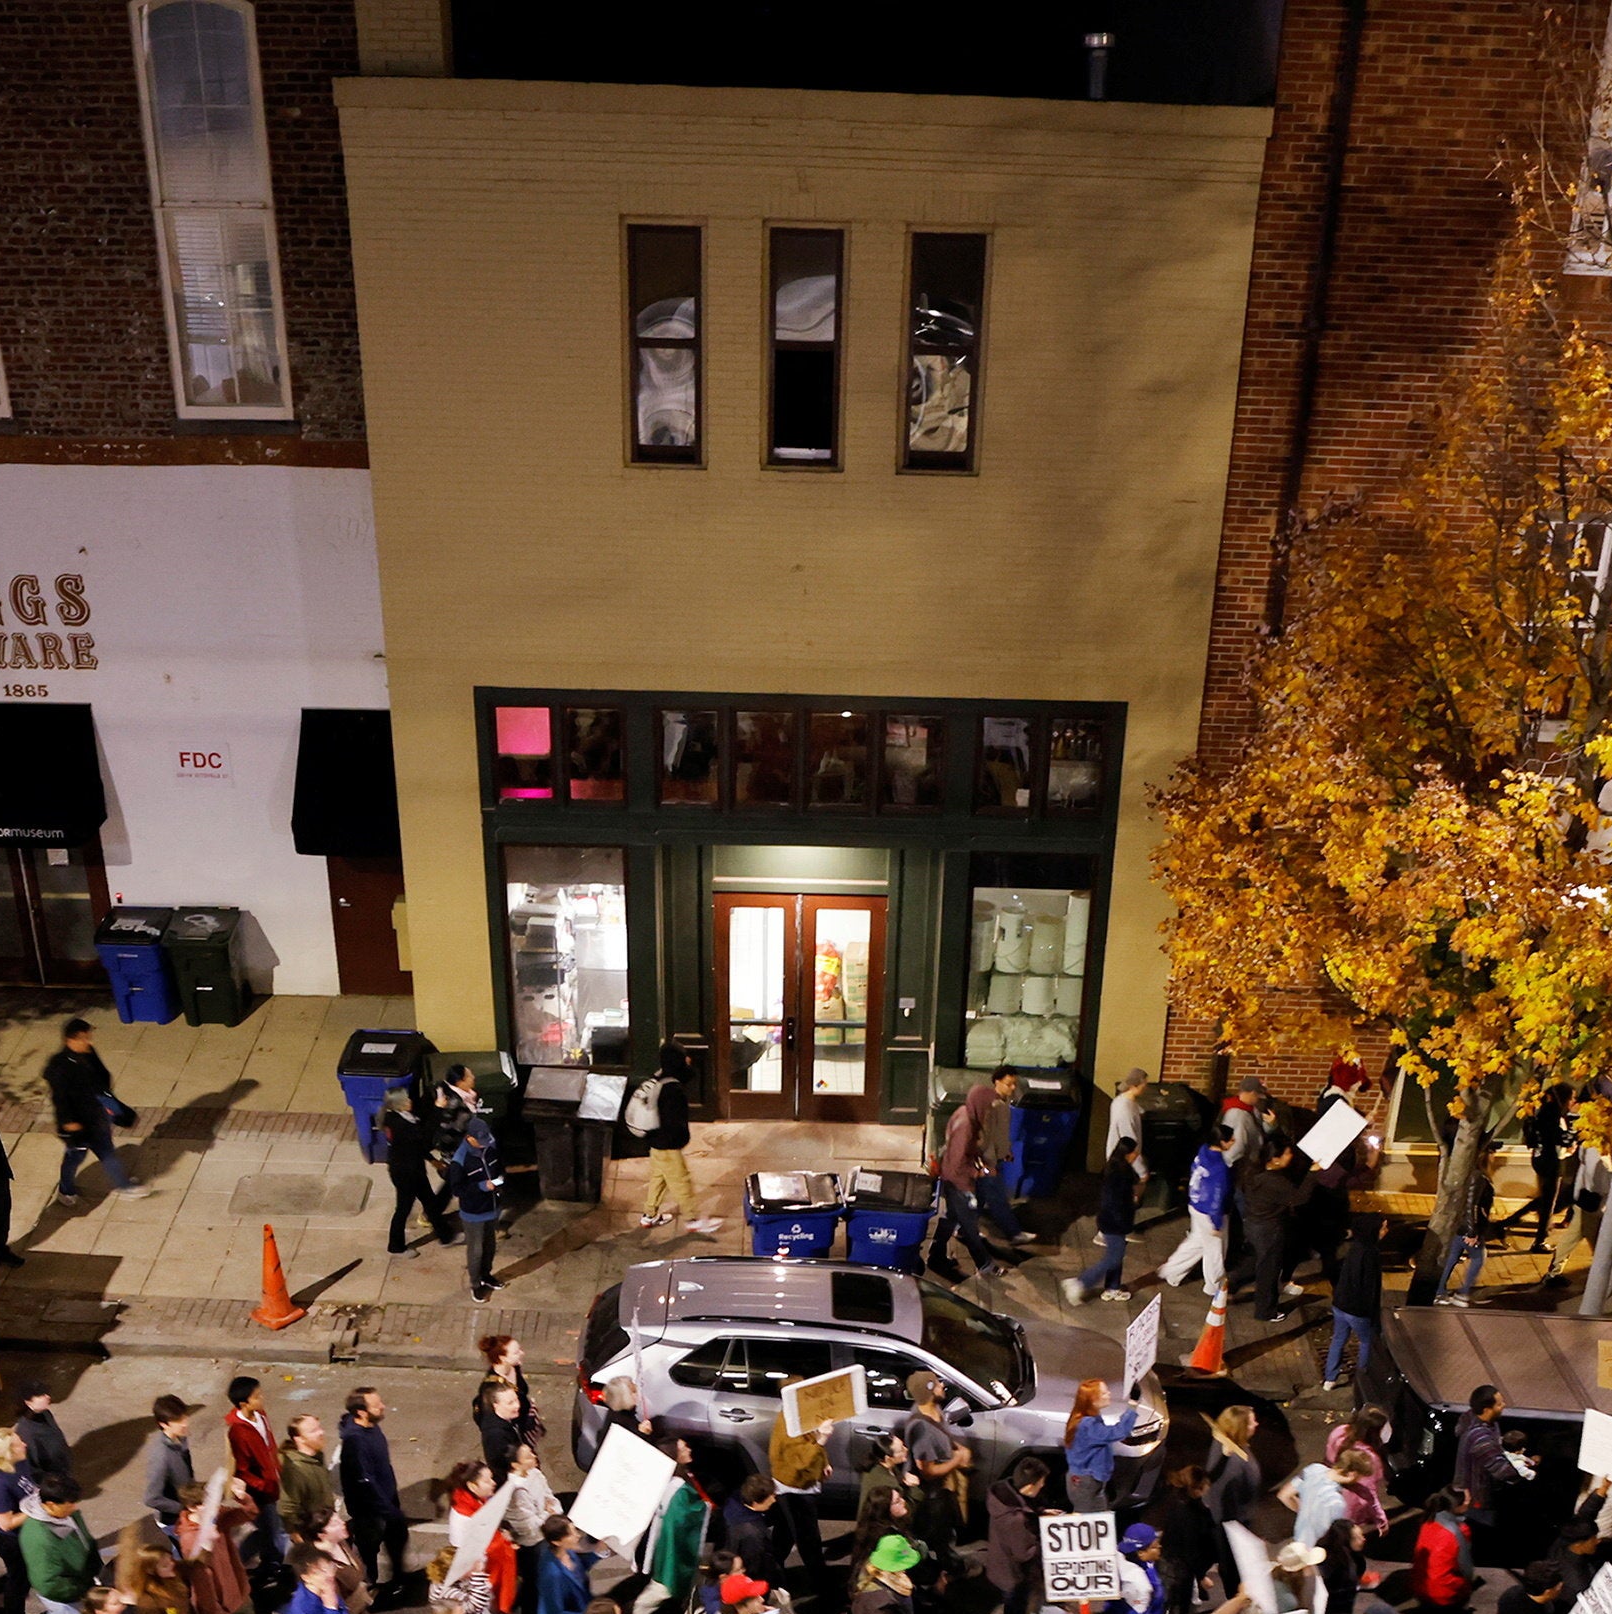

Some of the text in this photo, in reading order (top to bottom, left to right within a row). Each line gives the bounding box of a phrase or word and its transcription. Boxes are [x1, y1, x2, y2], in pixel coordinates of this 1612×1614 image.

[2, 683, 50, 699] 1865
[179, 749, 222, 770] FDC
[778, 1232, 814, 1241] Recycling
[1047, 1519, 1109, 1552] STOP
[1051, 1574, 1114, 1591] OUR
